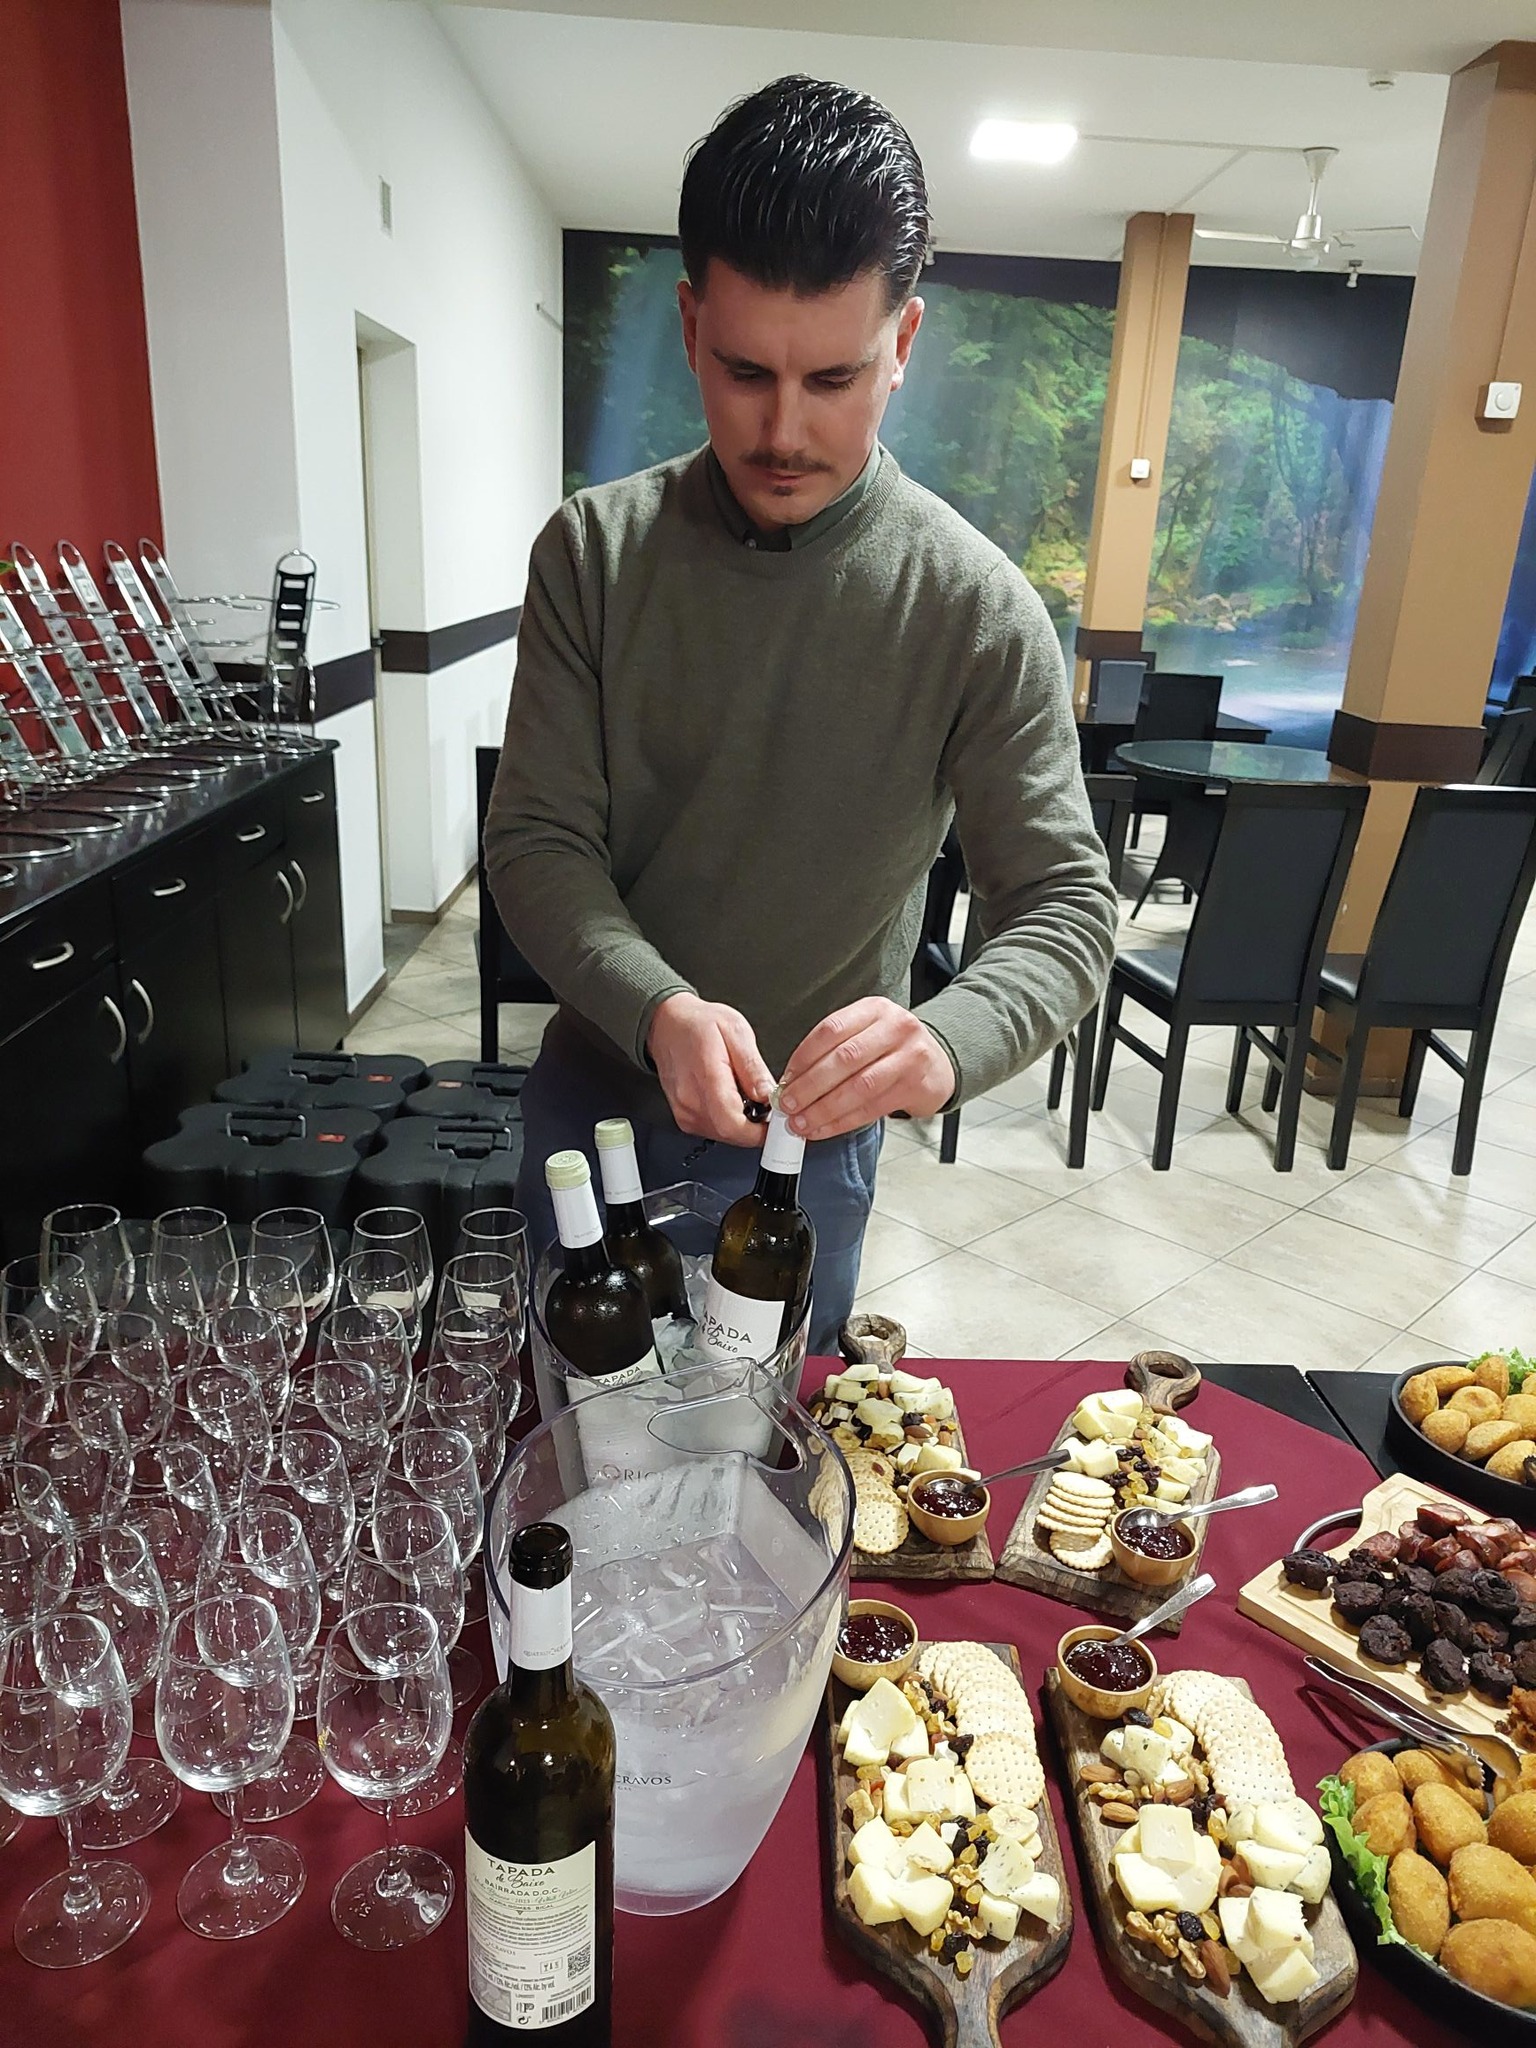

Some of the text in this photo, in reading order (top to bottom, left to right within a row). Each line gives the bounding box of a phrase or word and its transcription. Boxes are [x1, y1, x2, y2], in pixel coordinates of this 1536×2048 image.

[703, 1310, 752, 1344] APADA
[487, 1857, 555, 1877] TAPADA
[484, 1878, 531, 1897] BAIRRADA
[532, 1887, 562, 1897] D.O.C.
[495, 1873, 506, 1883] de
[507, 1874, 545, 1889] Baixo
